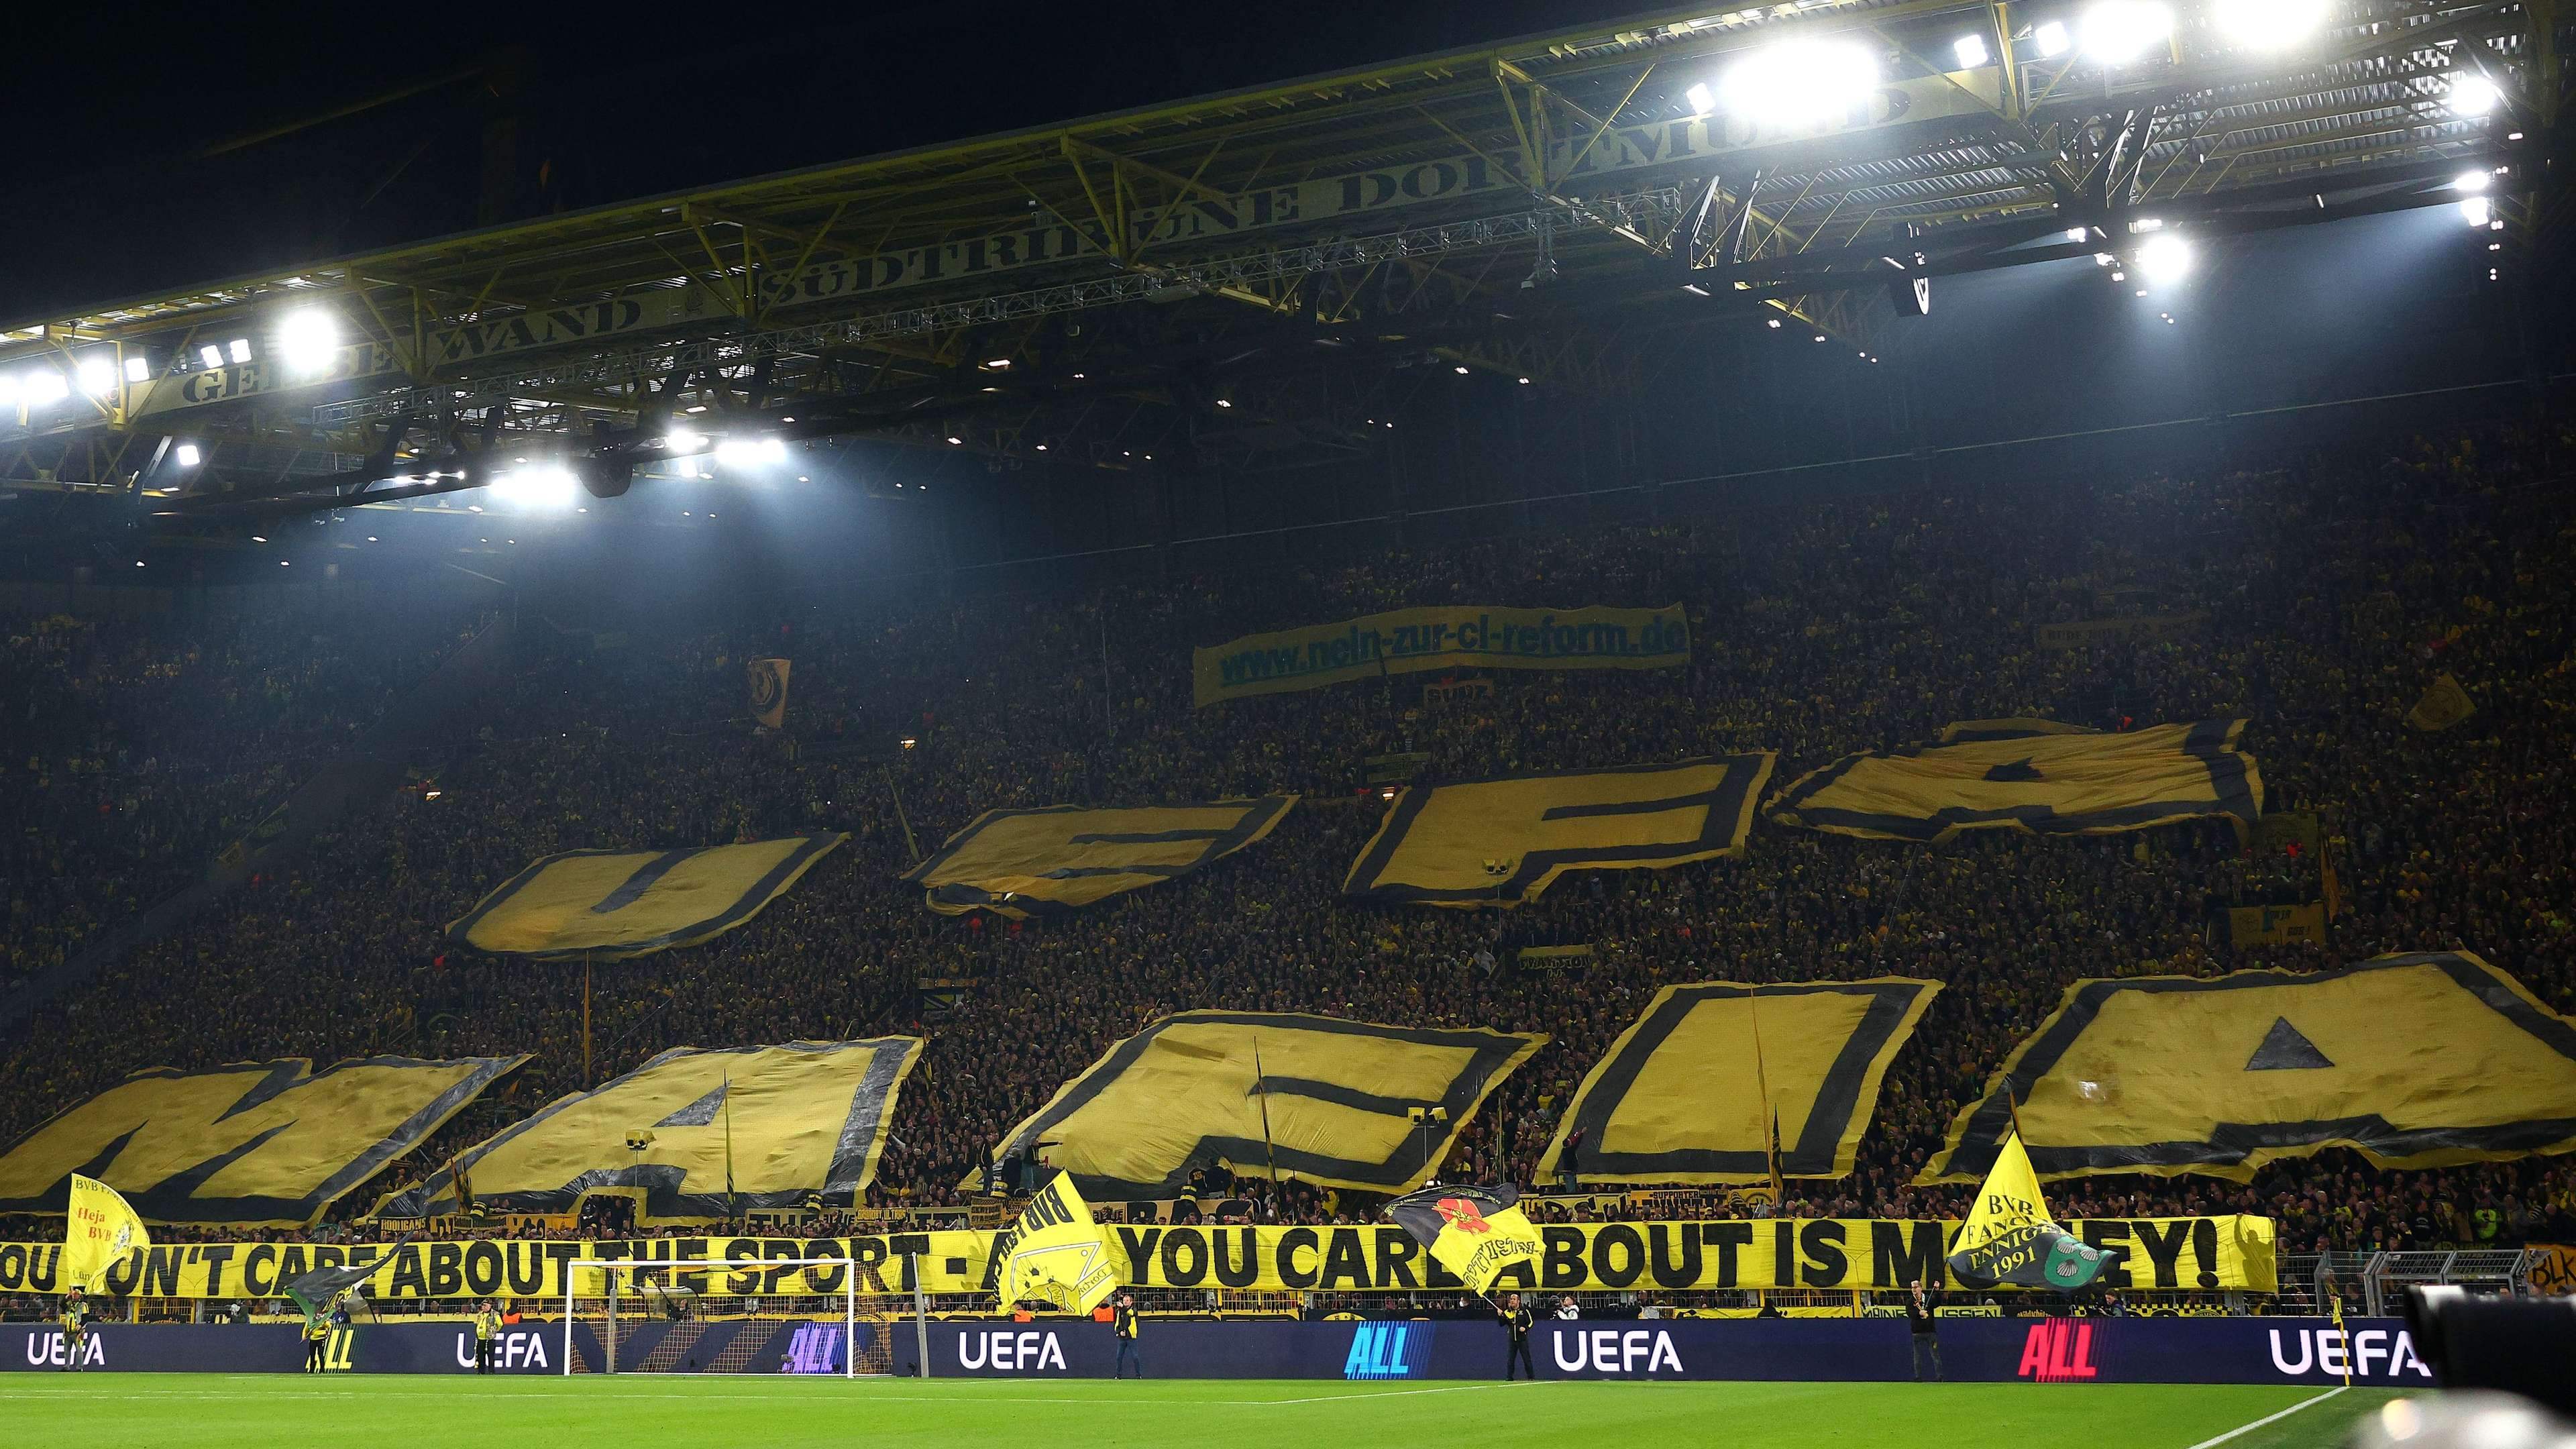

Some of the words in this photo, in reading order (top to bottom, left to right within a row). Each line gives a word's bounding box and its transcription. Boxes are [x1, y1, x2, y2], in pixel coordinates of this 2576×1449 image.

[1337, 88, 1912, 213] DORTMUD
[182, 341, 394, 404] GEE
[435, 299, 641, 361] WAND
[1219, 614, 1688, 685] www.nein-zur-cl-reform.de
[75, 1179, 98, 1191] BVB
[1988, 1195, 2033, 1215] BVB
[78, 1208, 105, 1224] Heja
[88, 1226, 112, 1242] BVB
[380, 1217, 427, 1231] HOOLIGANS
[0, 1244, 62, 1291] OU
[105, 1245, 234, 1297] ON'T
[390, 1240, 581, 1297] ABOUT
[594, 1239, 708, 1295] THE
[725, 1234, 930, 1295] SPORT
[1116, 1228, 1258, 1287] YOU
[1774, 1220, 1848, 1288] IS
[1870, 1218, 2219, 1289] MEY!
[1991, 1245, 2037, 1280] 1991
[959, 1332, 1067, 1370] UEFA
[1344, 1326, 1409, 1374] ALL
[1553, 1330, 1684, 1372] UEFA
[2018, 1324, 2097, 1377] ALL
[2269, 1329, 2432, 1377] UEFA
